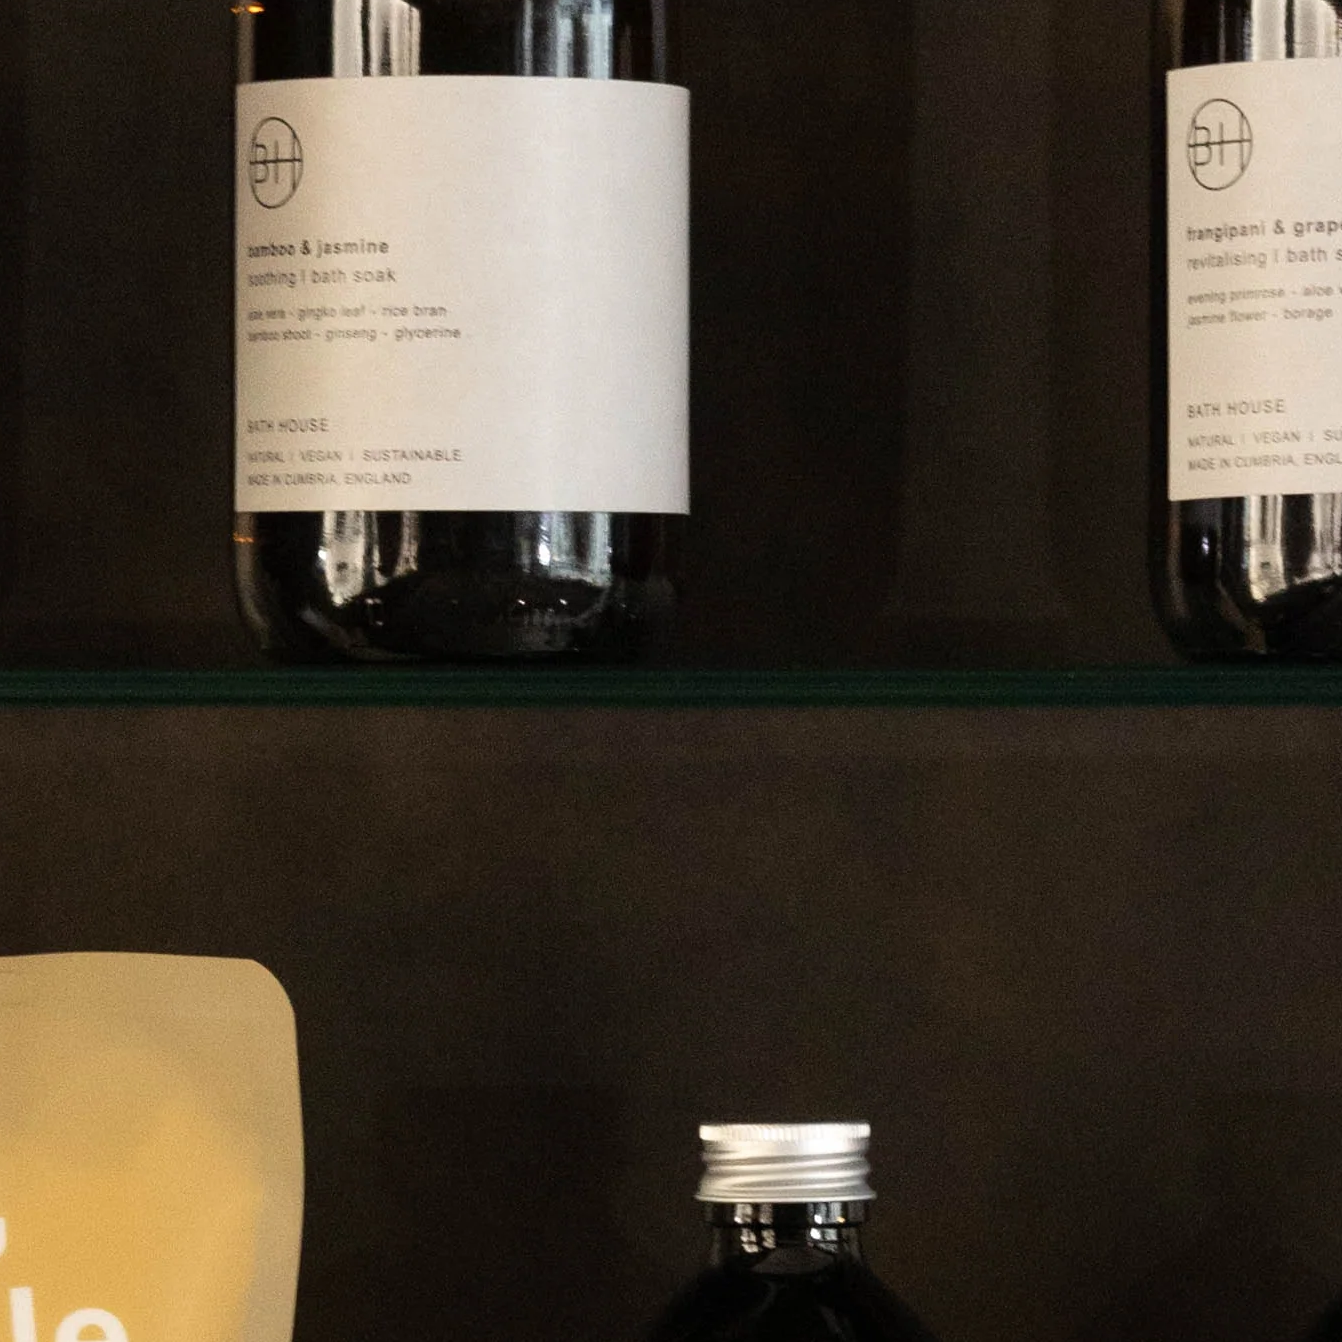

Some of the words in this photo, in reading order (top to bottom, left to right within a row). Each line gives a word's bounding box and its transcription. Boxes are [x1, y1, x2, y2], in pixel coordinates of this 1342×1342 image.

[1273, 219, 1286, 235] &
[300, 239, 311, 255] &
[316, 239, 389, 258] jasmine
[1187, 251, 1267, 270] revitalising
[1285, 247, 1328, 263] bath
[312, 269, 346, 284] bath
[353, 268, 396, 283] soak
[1187, 403, 1221, 418] BATH
[1227, 398, 1286, 415] HOUSE
[279, 417, 329, 433] HOUSE
[1254, 430, 1301, 444] VEGAN
[362, 449, 463, 463] SUSTAINABLE
[344, 472, 412, 485] ENGLAND
